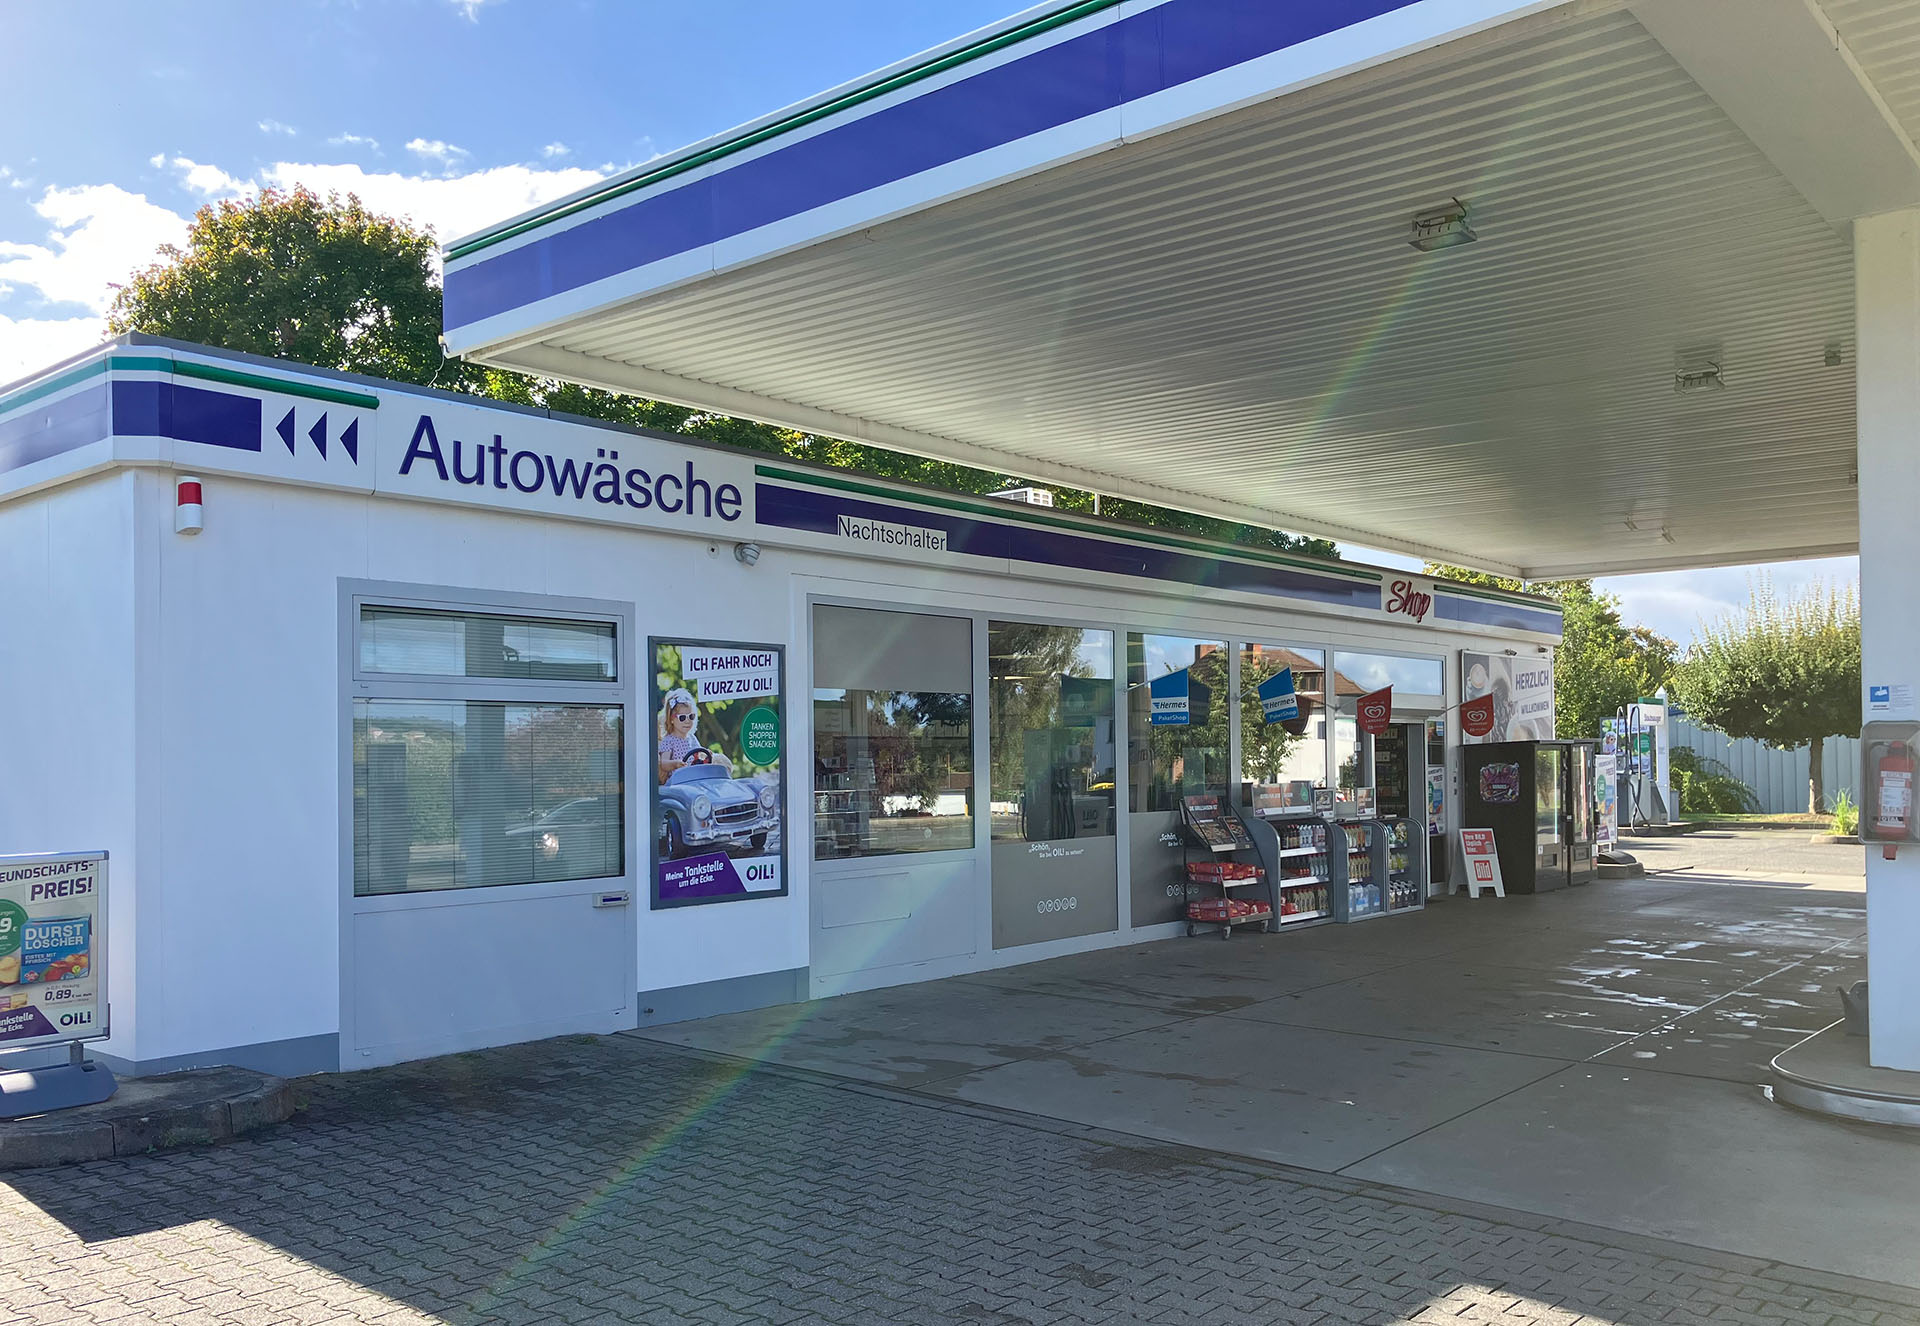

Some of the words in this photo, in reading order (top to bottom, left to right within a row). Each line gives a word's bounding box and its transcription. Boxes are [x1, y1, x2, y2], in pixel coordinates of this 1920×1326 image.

[398, 415, 743, 522] Autowäsche
[838, 516, 946, 550] Nachtschalter
[1385, 580, 1431, 623] Shop
[690, 658, 708, 671] ICH
[711, 656, 740, 670] FAHR
[743, 654, 772, 668] NOCH
[704, 681, 733, 695] KURZ
[736, 679, 750, 692] ZU
[753, 678, 772, 691] OIL!
[1515, 669, 1549, 690] HERZLICH
[1269, 697, 1295, 709] Hermes
[751, 722, 774, 730] TANKEN
[748, 731, 777, 739] SHOPPEN
[748, 740, 777, 748] SNACKEN
[665, 871, 684, 882] Meine
[684, 861, 724, 878] Tankstelle
[746, 864, 774, 881] OIL!
[690, 876, 699, 886] die
[700, 874, 715, 884] Ecke.
[31, 877, 93, 901] PREIS!
[25, 924, 84, 940] DURST
[0, 1012, 34, 1027] nkstelle
[60, 1011, 91, 1026] OIL!
[8, 1023, 24, 1032] Ecke.
